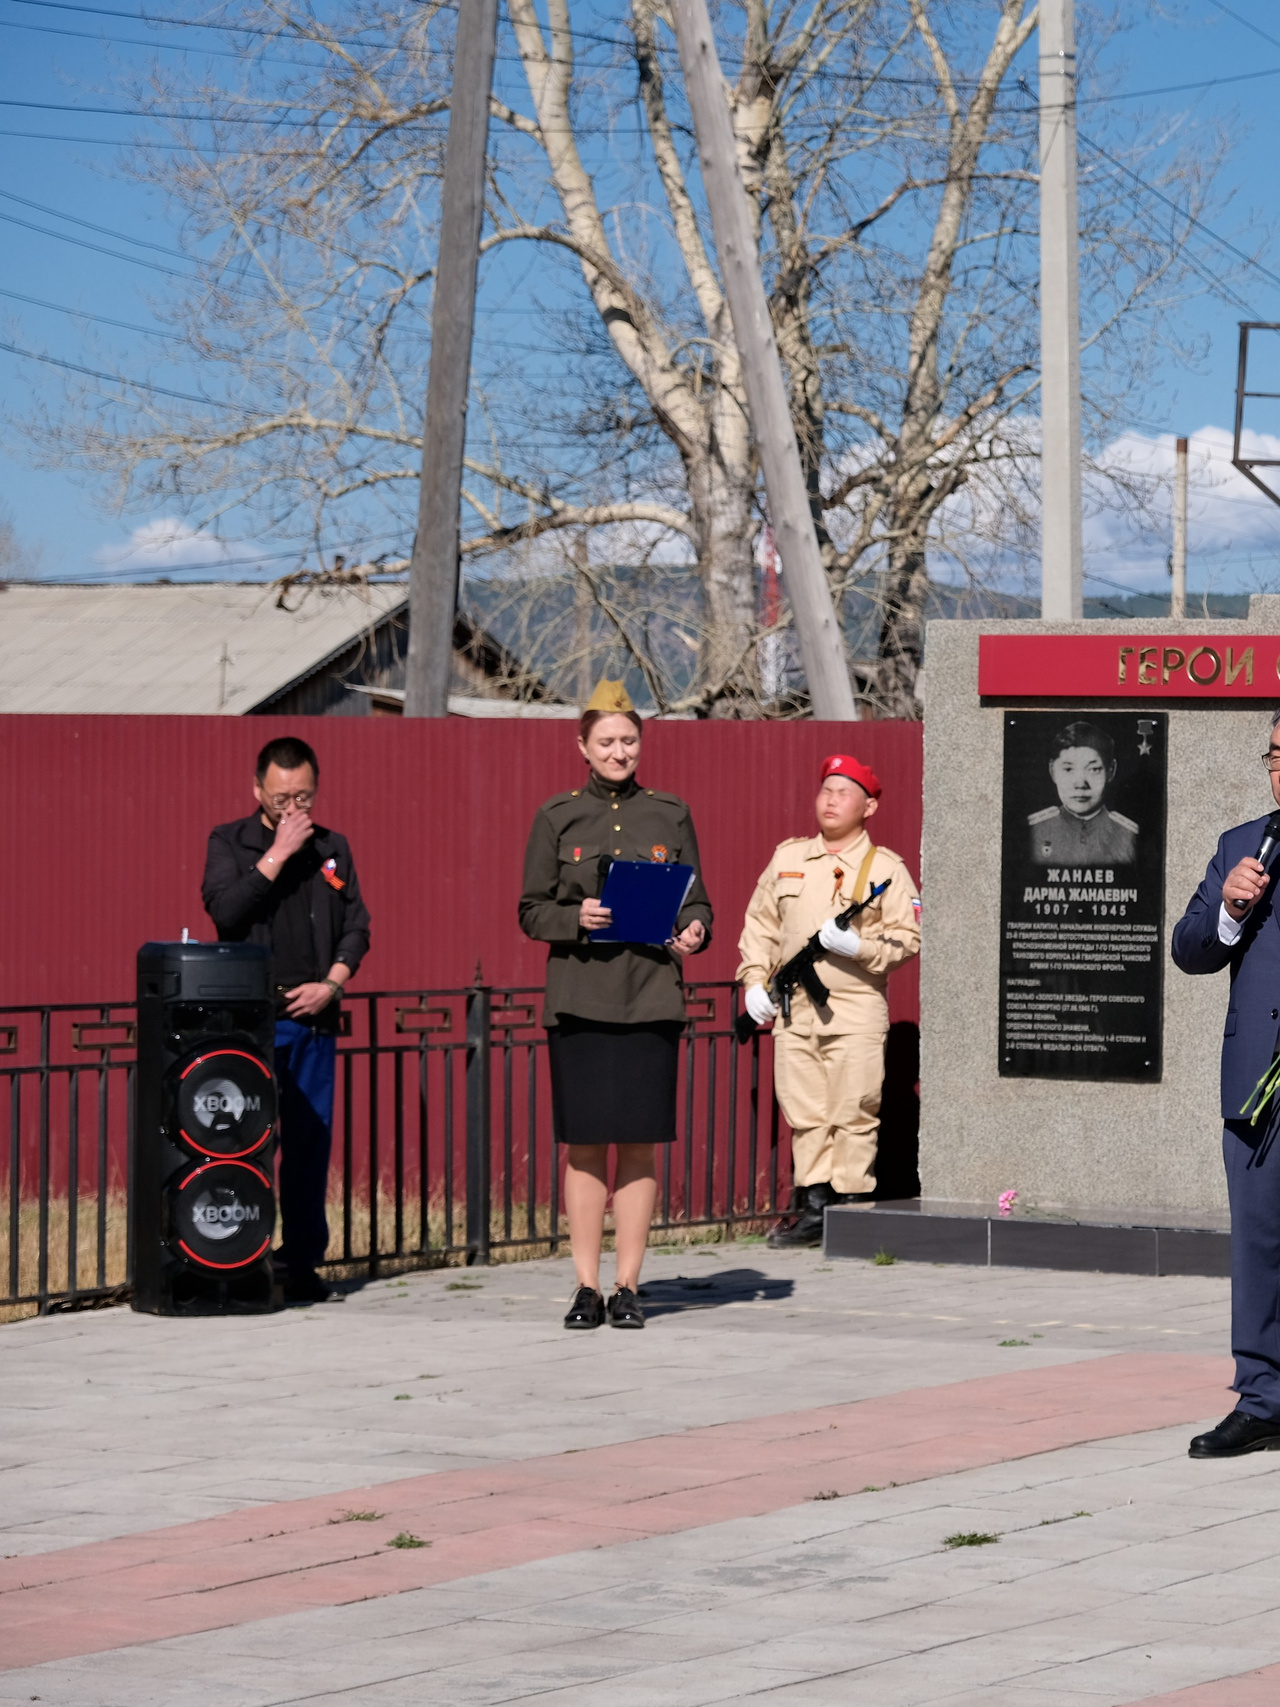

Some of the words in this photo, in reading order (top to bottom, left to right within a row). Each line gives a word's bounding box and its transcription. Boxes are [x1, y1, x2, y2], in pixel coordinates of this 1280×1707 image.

[1117, 646, 1254, 687] ГЕРОИ
[1047, 869, 1114, 883] ЖАНАЕВ
[1024, 887, 1066, 902] ДАРМА
[1069, 888, 1138, 903] ЖАНАЕВИЧ
[1035, 904, 1069, 915] 1907
[1092, 905, 1126, 916] 1945
[193, 1095, 260, 1113] XBOOM
[192, 1205, 260, 1223] XBOOM
